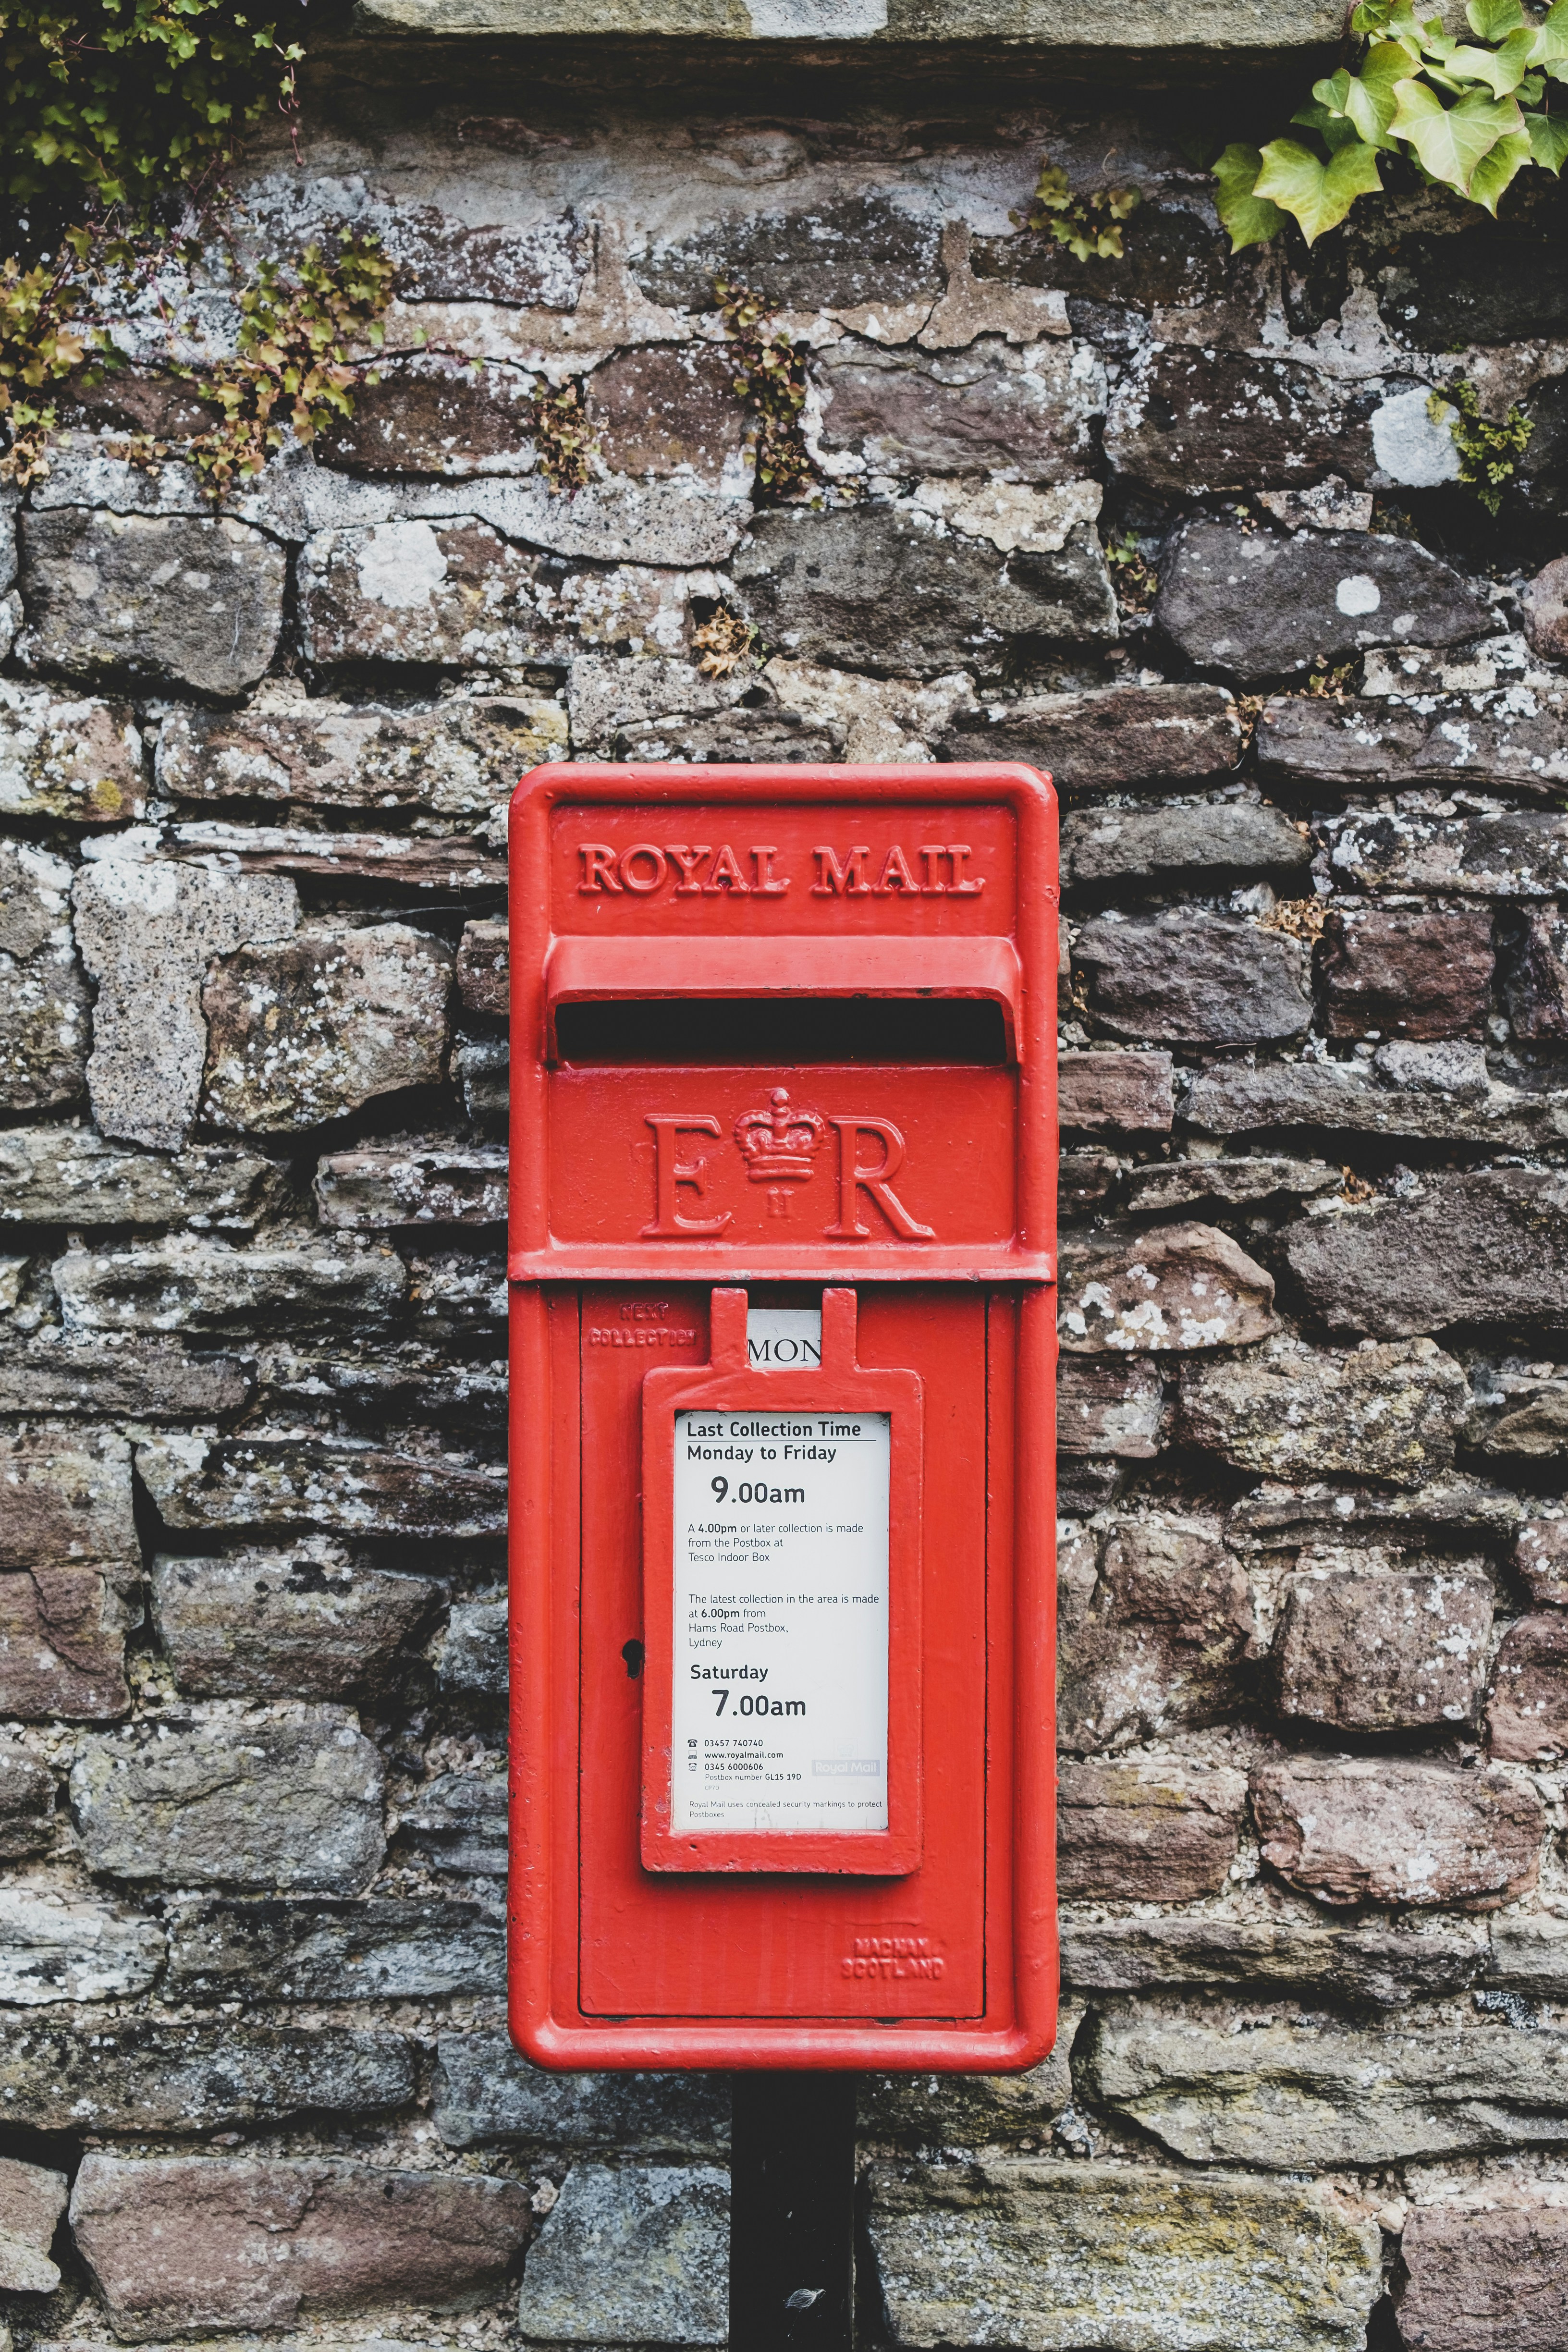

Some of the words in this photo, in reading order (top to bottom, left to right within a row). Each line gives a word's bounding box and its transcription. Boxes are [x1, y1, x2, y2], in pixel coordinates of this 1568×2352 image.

[577, 844, 791, 896] ROYAL
[809, 845, 986, 896] MAIL
[638, 1113, 733, 1238] E
[822, 1115, 937, 1240] R
[620, 1302, 669, 1321] NEXT
[589, 1328, 696, 1347] COLLECTION
[747, 1339, 821, 1364] MON
[687, 1421, 724, 1437] Last
[730, 1421, 813, 1437] Collection
[818, 1421, 861, 1437] Time
[687, 1445, 754, 1463] Monday
[760, 1446, 776, 1460] to
[784, 1445, 836, 1463] Friday
[711, 1476, 805, 1503] 9.00am
[688, 1523, 695, 1533] A
[698, 1523, 737, 1535] 4.00pm
[754, 1523, 775, 1533] later
[778, 1523, 822, 1533] collection
[826, 1523, 833, 1532] is
[836, 1523, 863, 1532] made
[688, 1538, 711, 1547] from
[714, 1538, 730, 1547] the
[734, 1538, 771, 1547] Postbox
[774, 1538, 784, 1547] at
[688, 1552, 714, 1562] Tesco
[718, 1552, 749, 1562] Indoor
[752, 1552, 770, 1562] Box
[688, 1594, 707, 1604] The
[710, 1594, 736, 1604] latest
[739, 1594, 783, 1604] collection
[787, 1594, 795, 1604] in
[798, 1594, 814, 1604] the
[842, 1594, 849, 1603] is
[852, 1593, 879, 1604] made
[688, 1610, 698, 1618] at
[701, 1608, 740, 1620] 6.00pm
[743, 1608, 766, 1618] from
[689, 1623, 717, 1632] Hams
[721, 1623, 744, 1632] Road
[748, 1623, 788, 1633] Postbox,
[689, 1637, 723, 1649] Lydney
[690, 1664, 768, 1682] Saturday
[711, 1690, 806, 1717] 7.00am
[705, 1751, 784, 1760] www.royalmail.com
[815, 1762, 848, 1775] Royal
[850, 1762, 876, 1773] Mail
[689, 1801, 708, 1809] Royal
[783, 1801, 811, 1809] security
[813, 1801, 845, 1809] markings
[858, 1801, 882, 1809] protect
[841, 1957, 944, 1980] SCOTLAND
